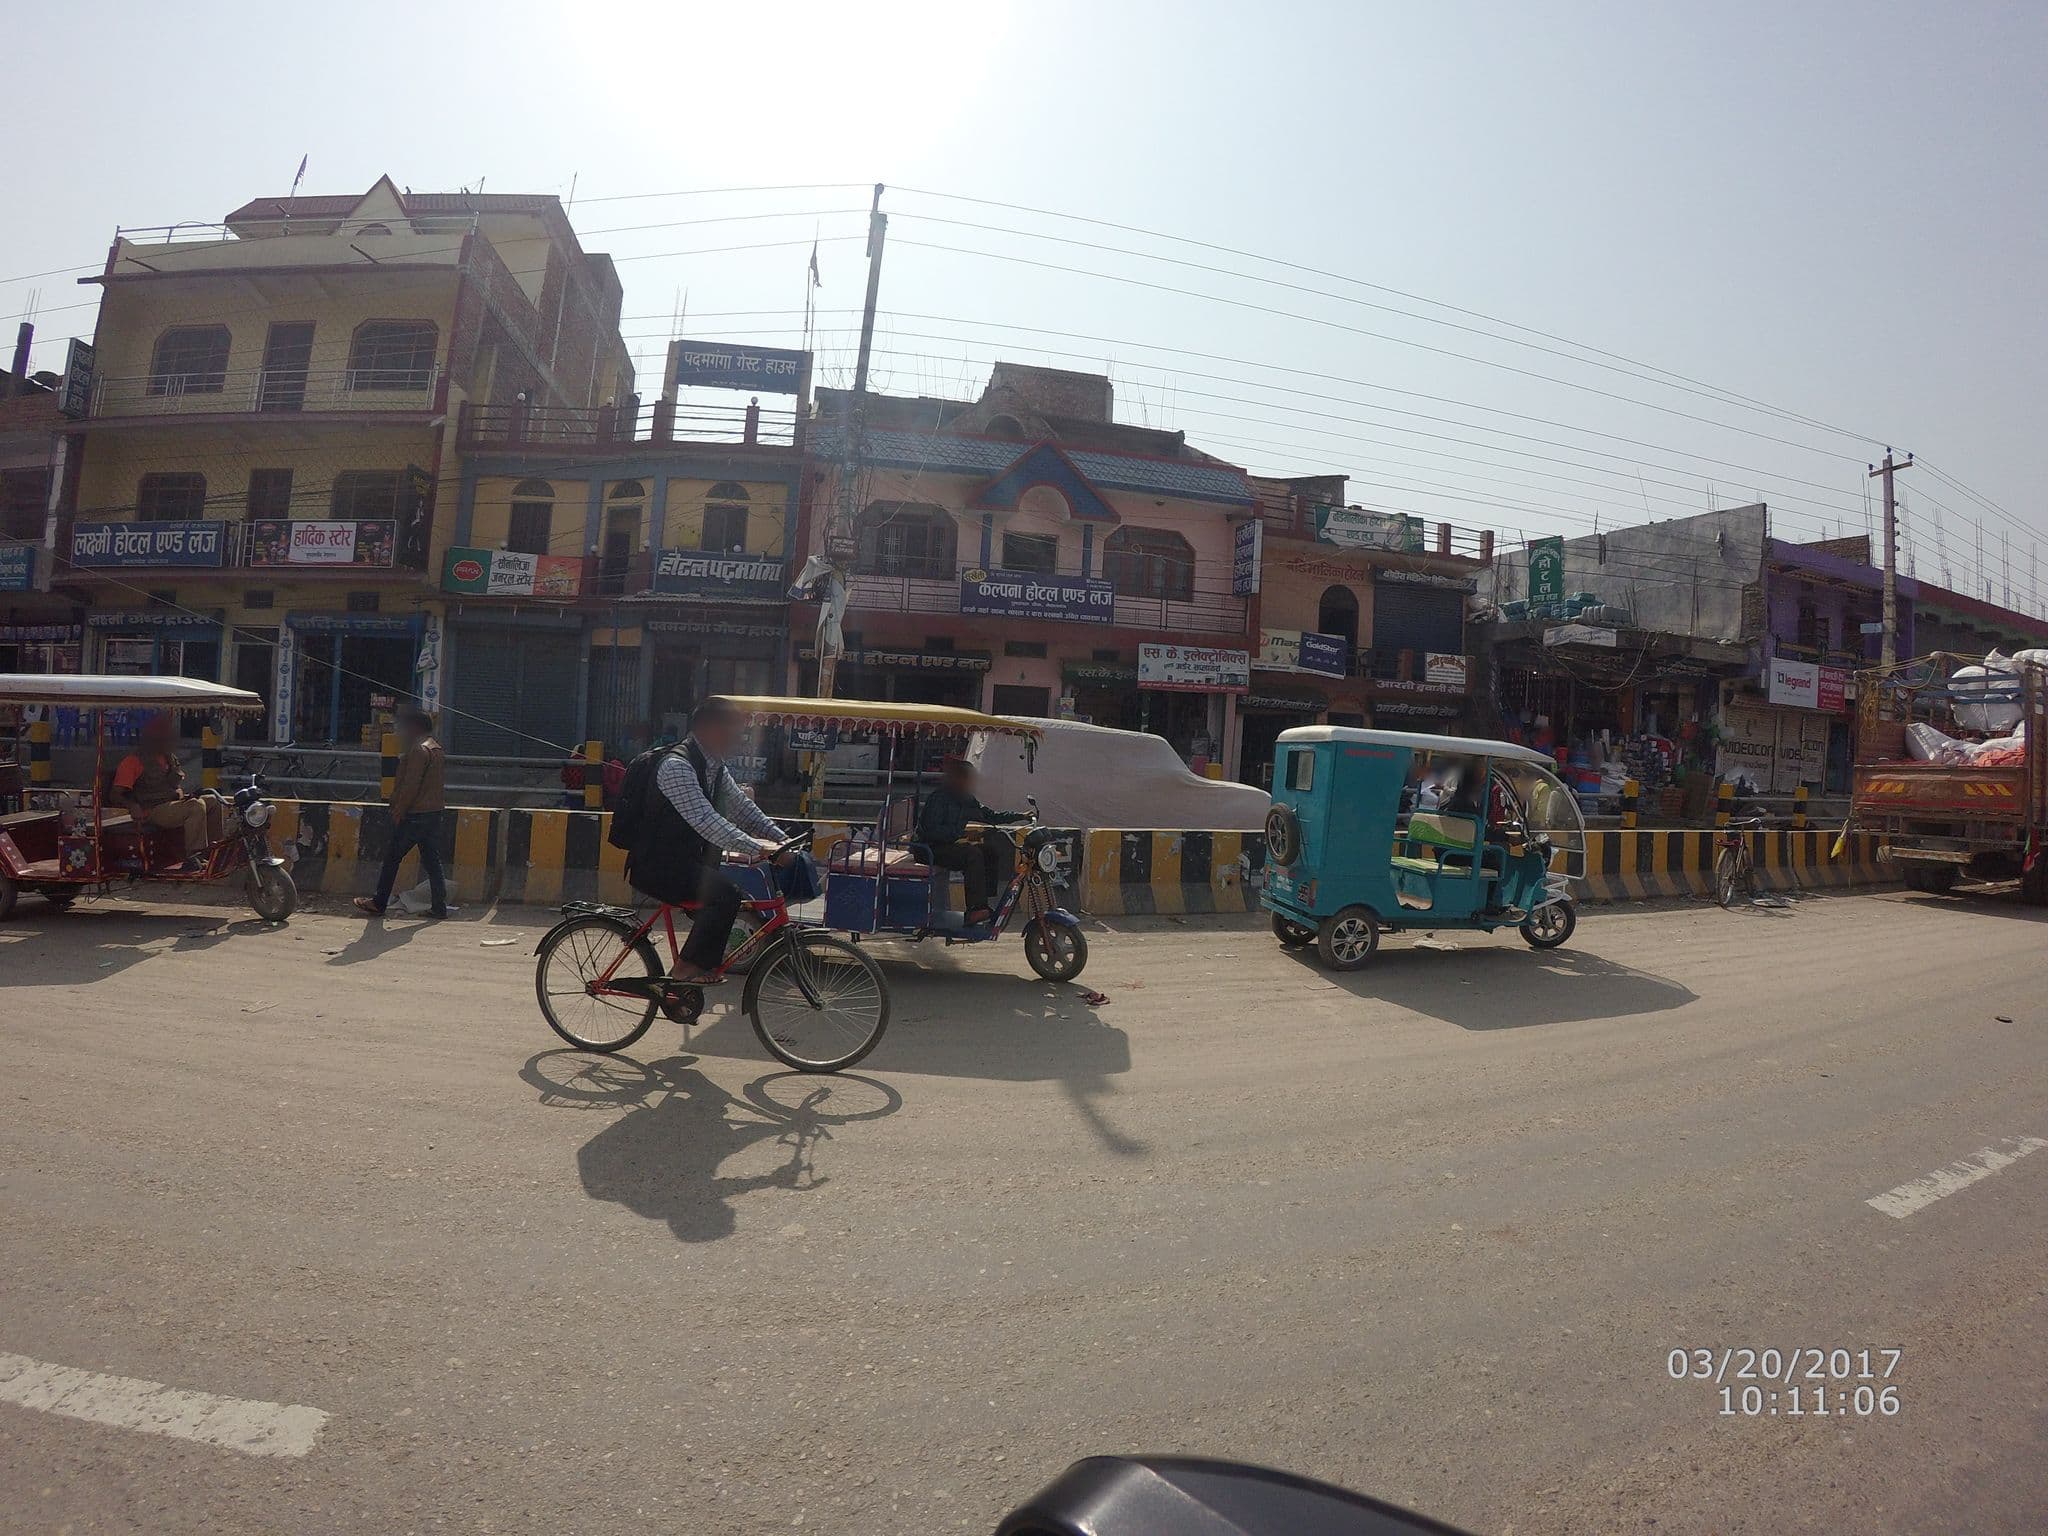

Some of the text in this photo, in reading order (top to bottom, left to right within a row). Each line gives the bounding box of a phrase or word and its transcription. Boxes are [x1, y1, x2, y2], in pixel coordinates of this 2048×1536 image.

[765, 358, 797, 376] हाउस
[74, 524, 218, 557] लक्ष्मी होटल एण्ड लज
[294, 524, 353, 547] हार्दिक स्टोर
[658, 552, 709, 578] होटल
[491, 572, 515, 585] जनरल
[978, 581, 1113, 606] कल्पना होटल एण्ड लज
[1785, 673, 1811, 689] legrand
